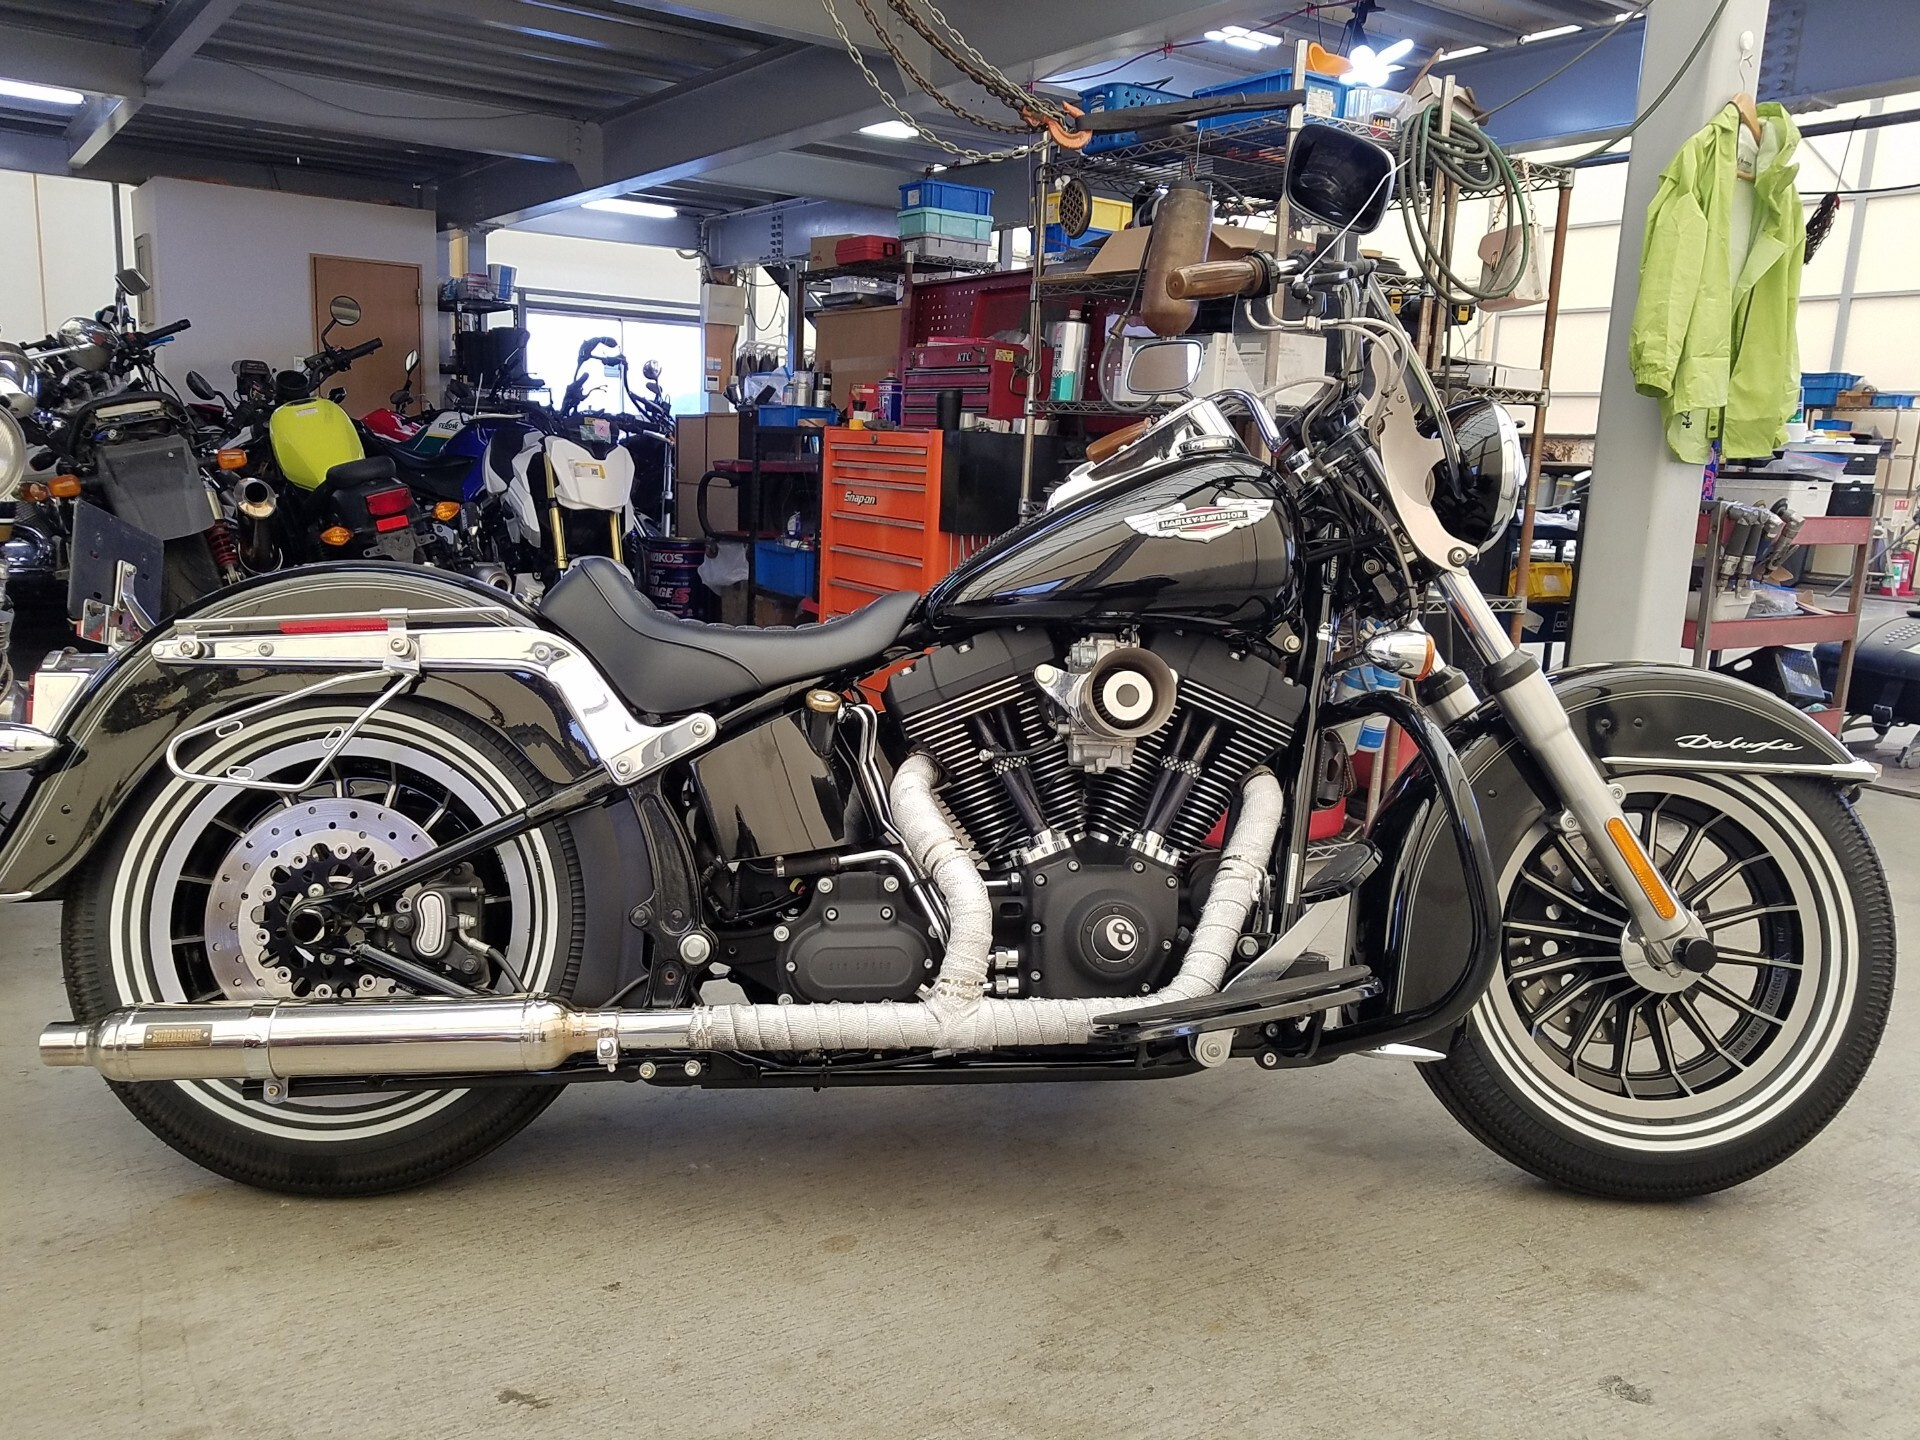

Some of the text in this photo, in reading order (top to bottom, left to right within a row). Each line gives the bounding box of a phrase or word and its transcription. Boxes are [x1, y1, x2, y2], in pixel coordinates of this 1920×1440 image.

[957, 352, 972, 362] KTC
[844, 490, 877, 506] Snap-on
[1674, 733, 1804, 754] Deluxe
[1113, 922, 1135, 946] 8
